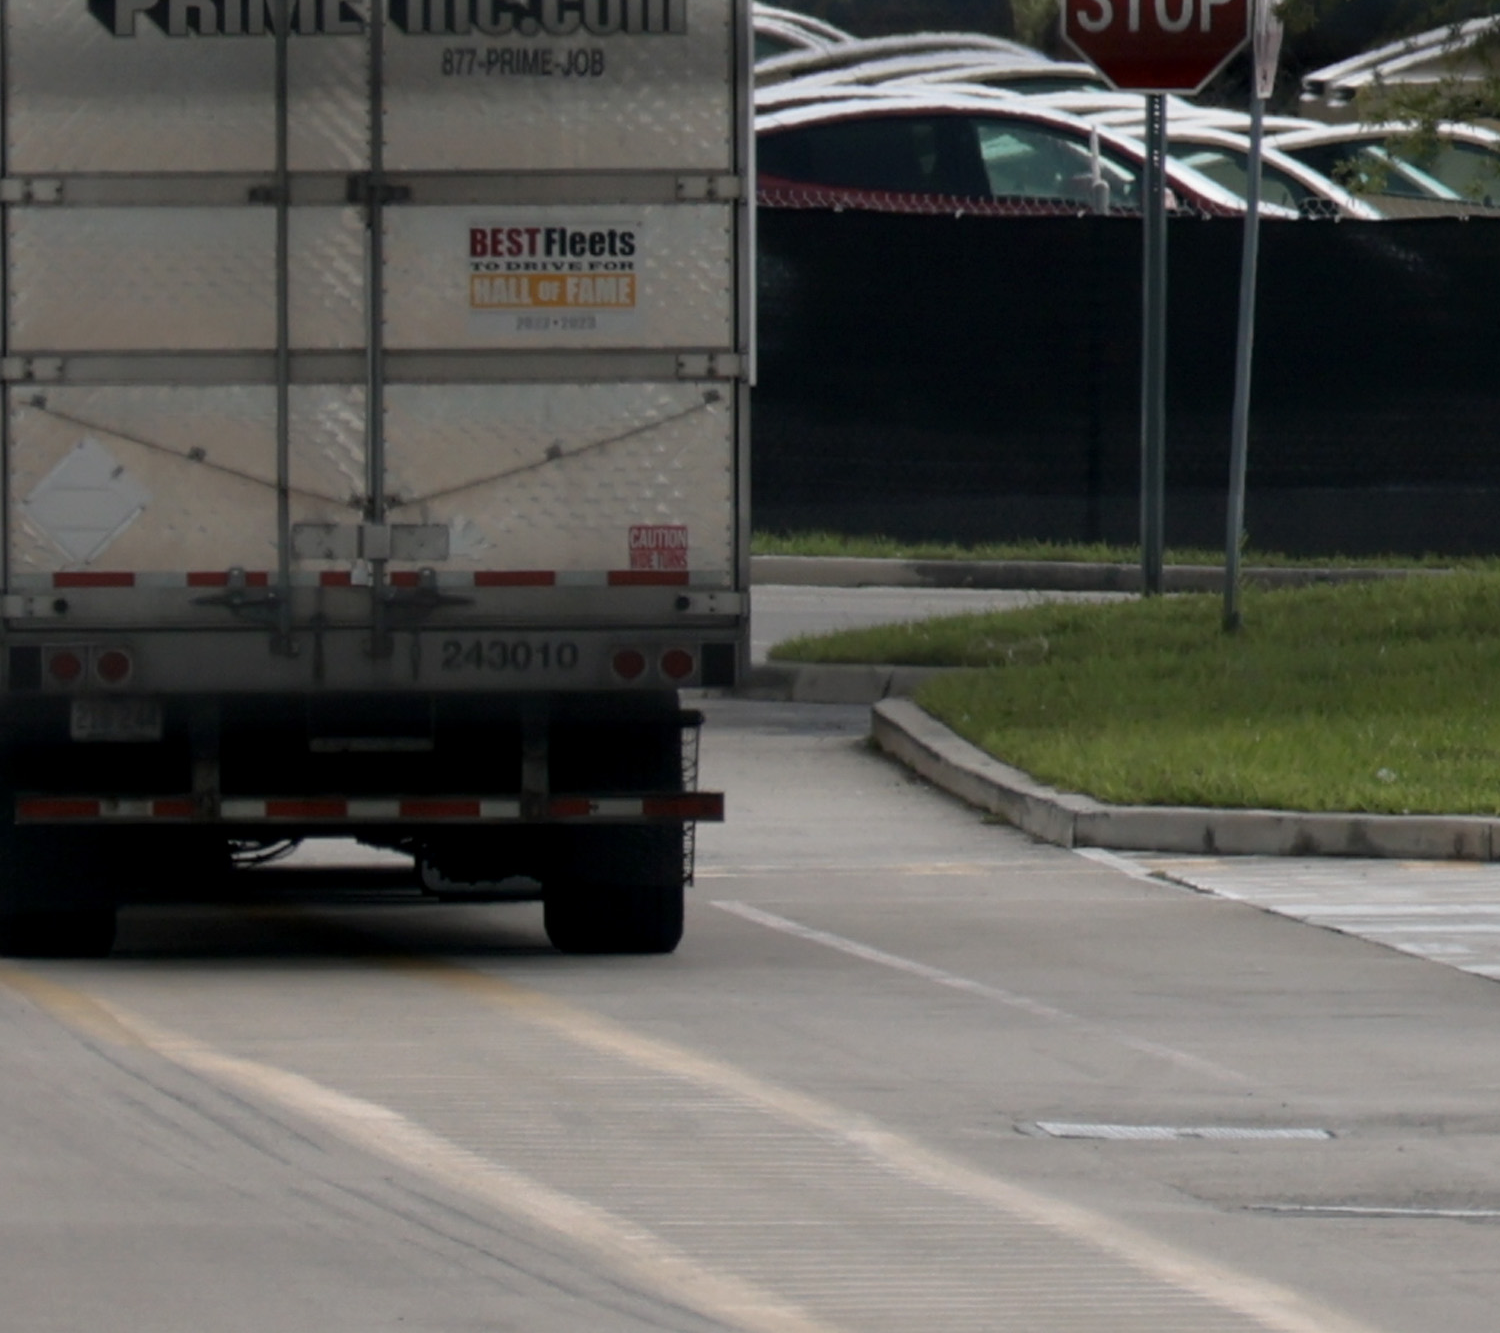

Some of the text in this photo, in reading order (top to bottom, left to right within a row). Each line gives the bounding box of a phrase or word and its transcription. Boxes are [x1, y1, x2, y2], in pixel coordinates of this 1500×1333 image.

[442, 47, 605, 78] 877-PRIME-JOB
[469, 260, 635, 271] TO DRIVE FOR
[474, 276, 632, 305] HALL OF FAME
[631, 528, 687, 548] CAUTION
[442, 639, 579, 672] 243010
